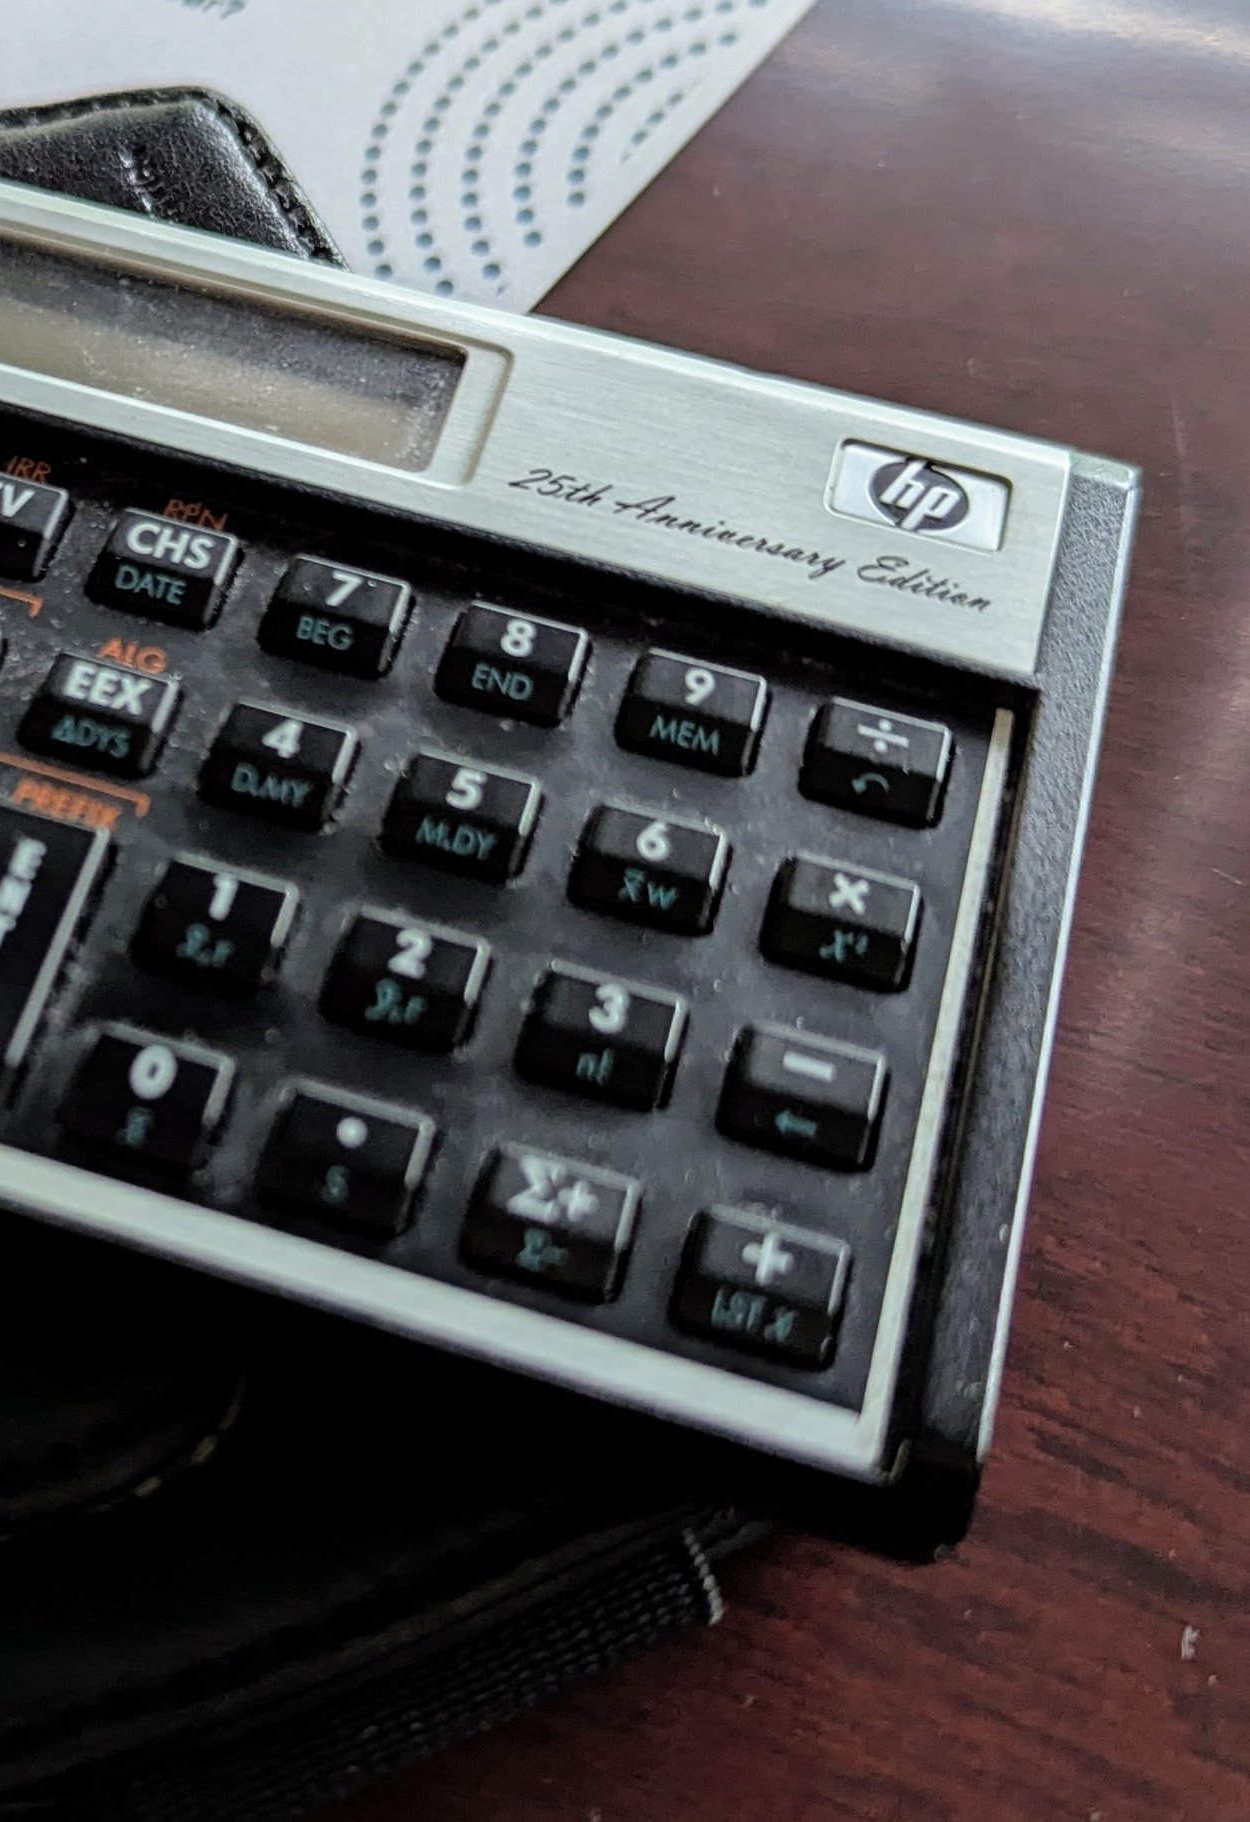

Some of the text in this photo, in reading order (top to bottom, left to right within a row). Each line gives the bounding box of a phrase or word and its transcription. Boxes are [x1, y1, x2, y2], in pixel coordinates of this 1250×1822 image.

[4, 454, 52, 484] IRR
[878, 457, 962, 532] hp
[125, 521, 218, 571] CHS
[506, 466, 994, 615] 25th Anniversary Edition
[113, 563, 189, 606] DATE
[324, 570, 365, 609] 7
[295, 613, 356, 652] BEG
[500, 617, 538, 658] 8
[59, 657, 153, 717] EEX
[470, 661, 535, 702] END
[683, 667, 717, 706] 9
[261, 718, 304, 760] 4
[647, 713, 721, 757] MEM
[445, 766, 488, 812] 5
[635, 820, 672, 862] 6
[207, 873, 241, 922] 1
[386, 926, 433, 980] 2
[588, 983, 631, 1036] 3
[128, 1042, 179, 1102] 0
